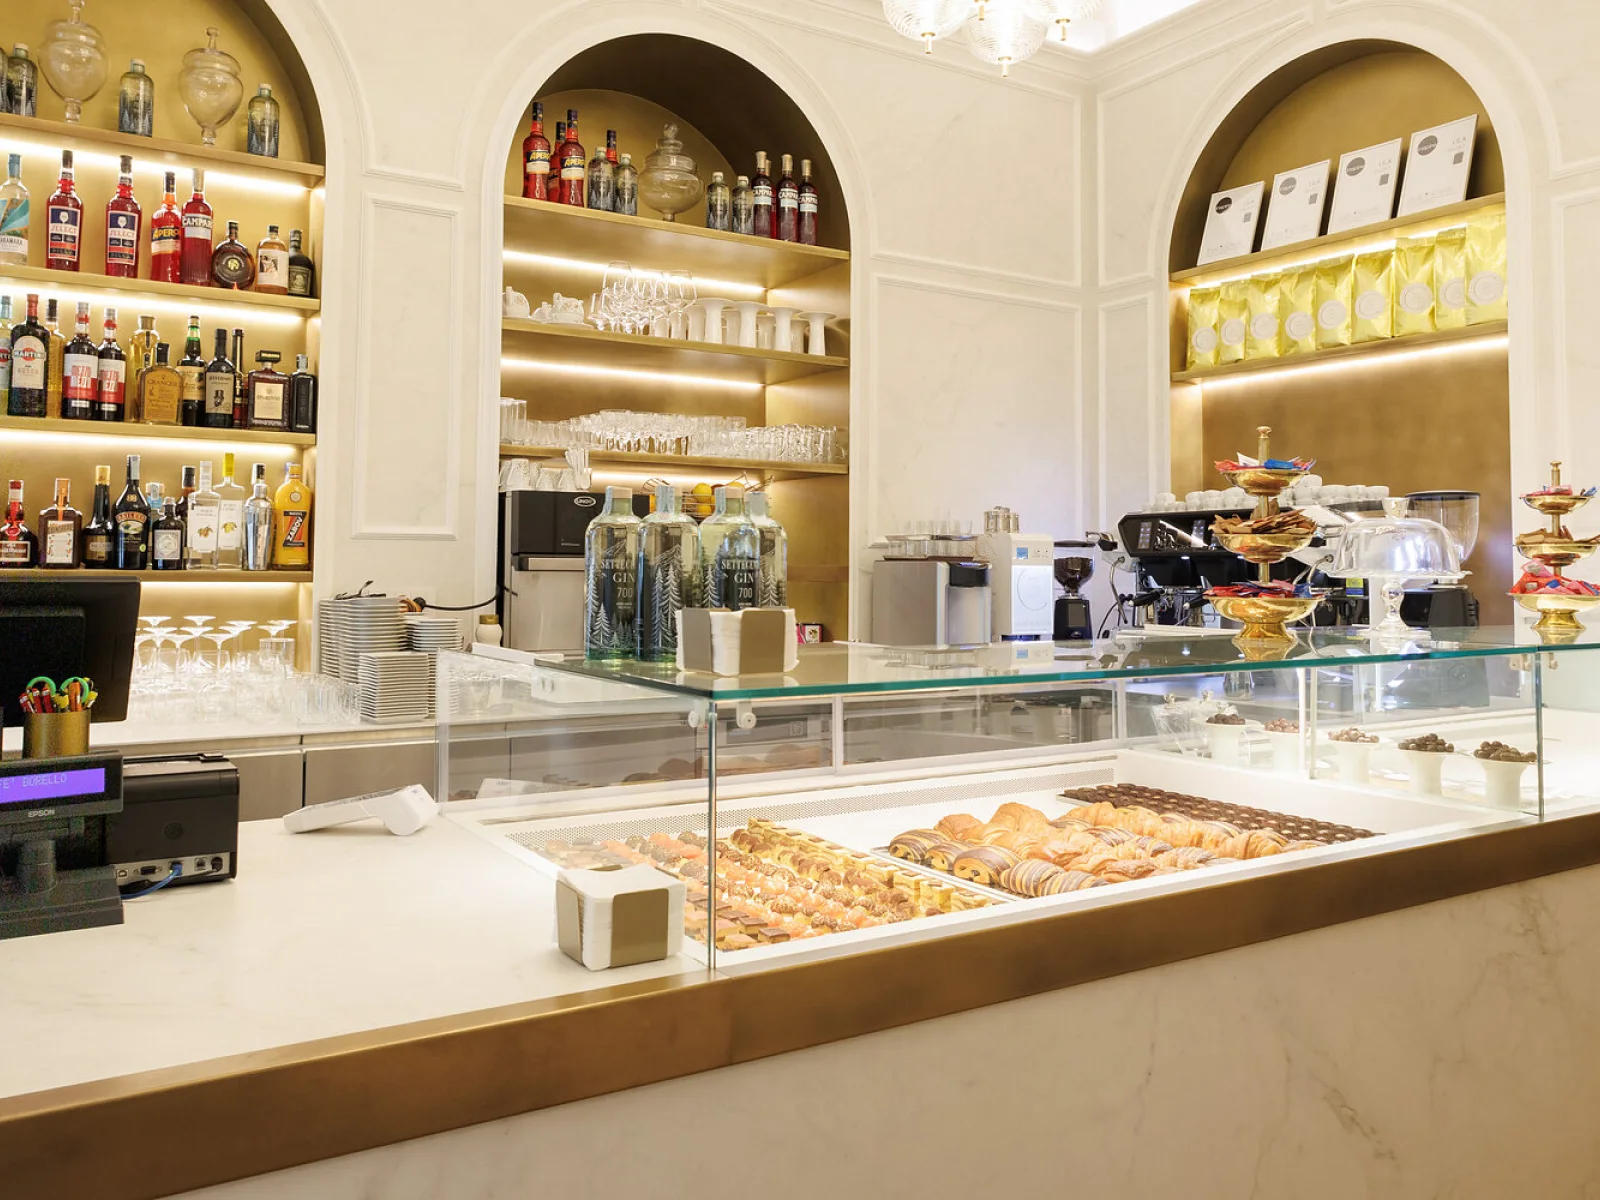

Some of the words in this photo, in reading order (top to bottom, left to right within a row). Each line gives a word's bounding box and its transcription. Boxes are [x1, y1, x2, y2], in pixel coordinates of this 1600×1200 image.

[613, 572, 635, 583] GIN
[734, 572, 754, 584] GIN
[617, 587, 632, 598] 700
[739, 587, 753, 599] 700
[22, 773, 67, 787] BORELLO
[28, 809, 55, 818] EPSON
